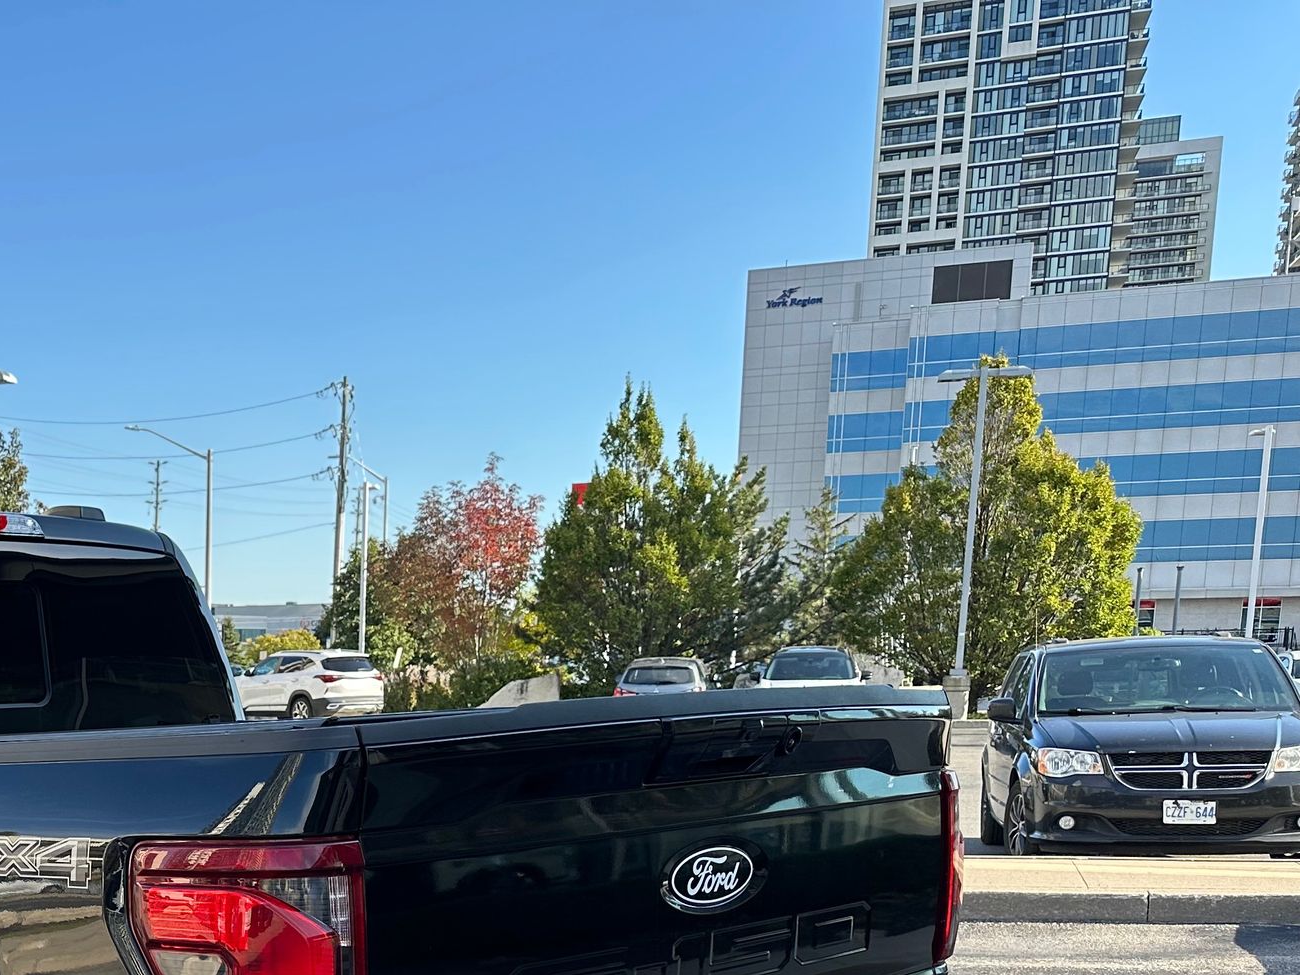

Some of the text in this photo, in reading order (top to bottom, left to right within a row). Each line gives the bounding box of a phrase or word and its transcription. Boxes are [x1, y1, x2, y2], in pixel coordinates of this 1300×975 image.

[766, 296, 823, 309] York Region
[1165, 806, 1215, 818] CZZF 644
[686, 855, 740, 896] Ford
